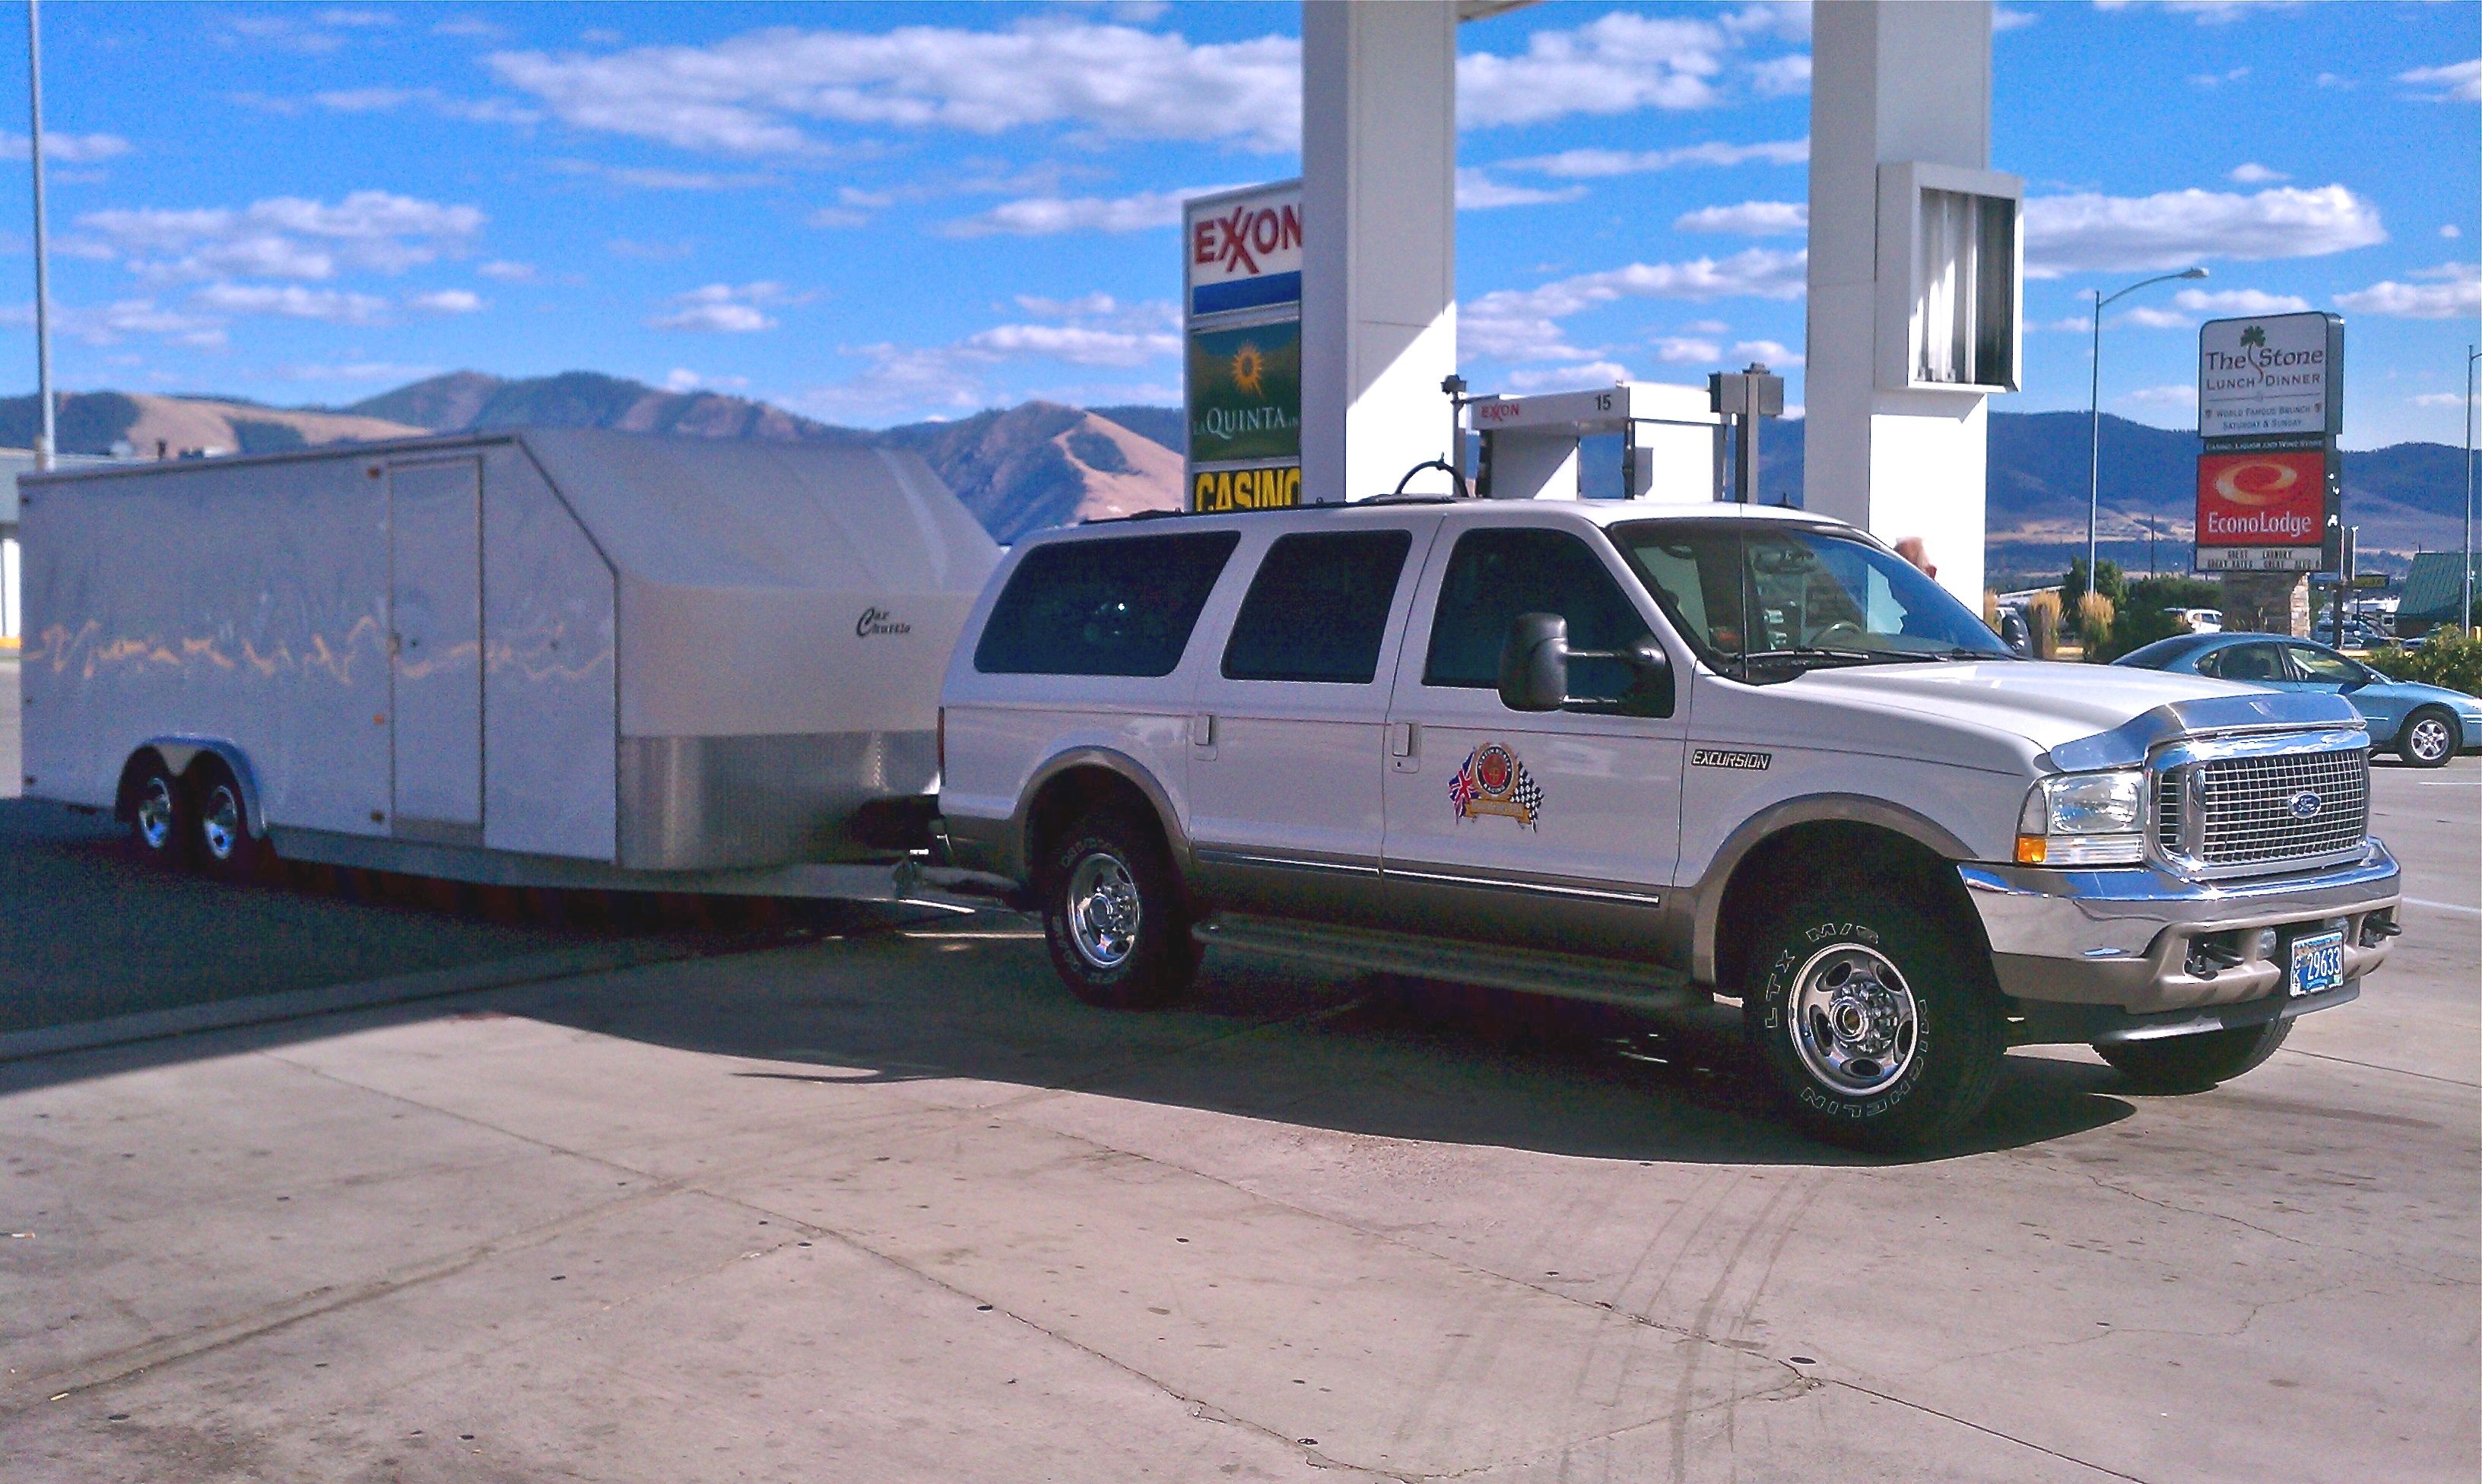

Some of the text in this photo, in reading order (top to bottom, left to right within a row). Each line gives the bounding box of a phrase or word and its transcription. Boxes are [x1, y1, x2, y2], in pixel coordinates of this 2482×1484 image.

[1194, 201, 1302, 274] EXXON
[2205, 347, 2324, 370] The Stone
[2207, 373, 2320, 391] LUNCH DINNER
[1481, 394, 1612, 421] EXXON 15
[1206, 406, 1286, 440] QUINTA
[1195, 467, 1301, 512] CASINO
[2208, 511, 2312, 537] EconoLodge
[1692, 750, 1769, 769] EXCURSION
[2306, 947, 2341, 981] 29633
[1764, 948, 1796, 1029] LTX
